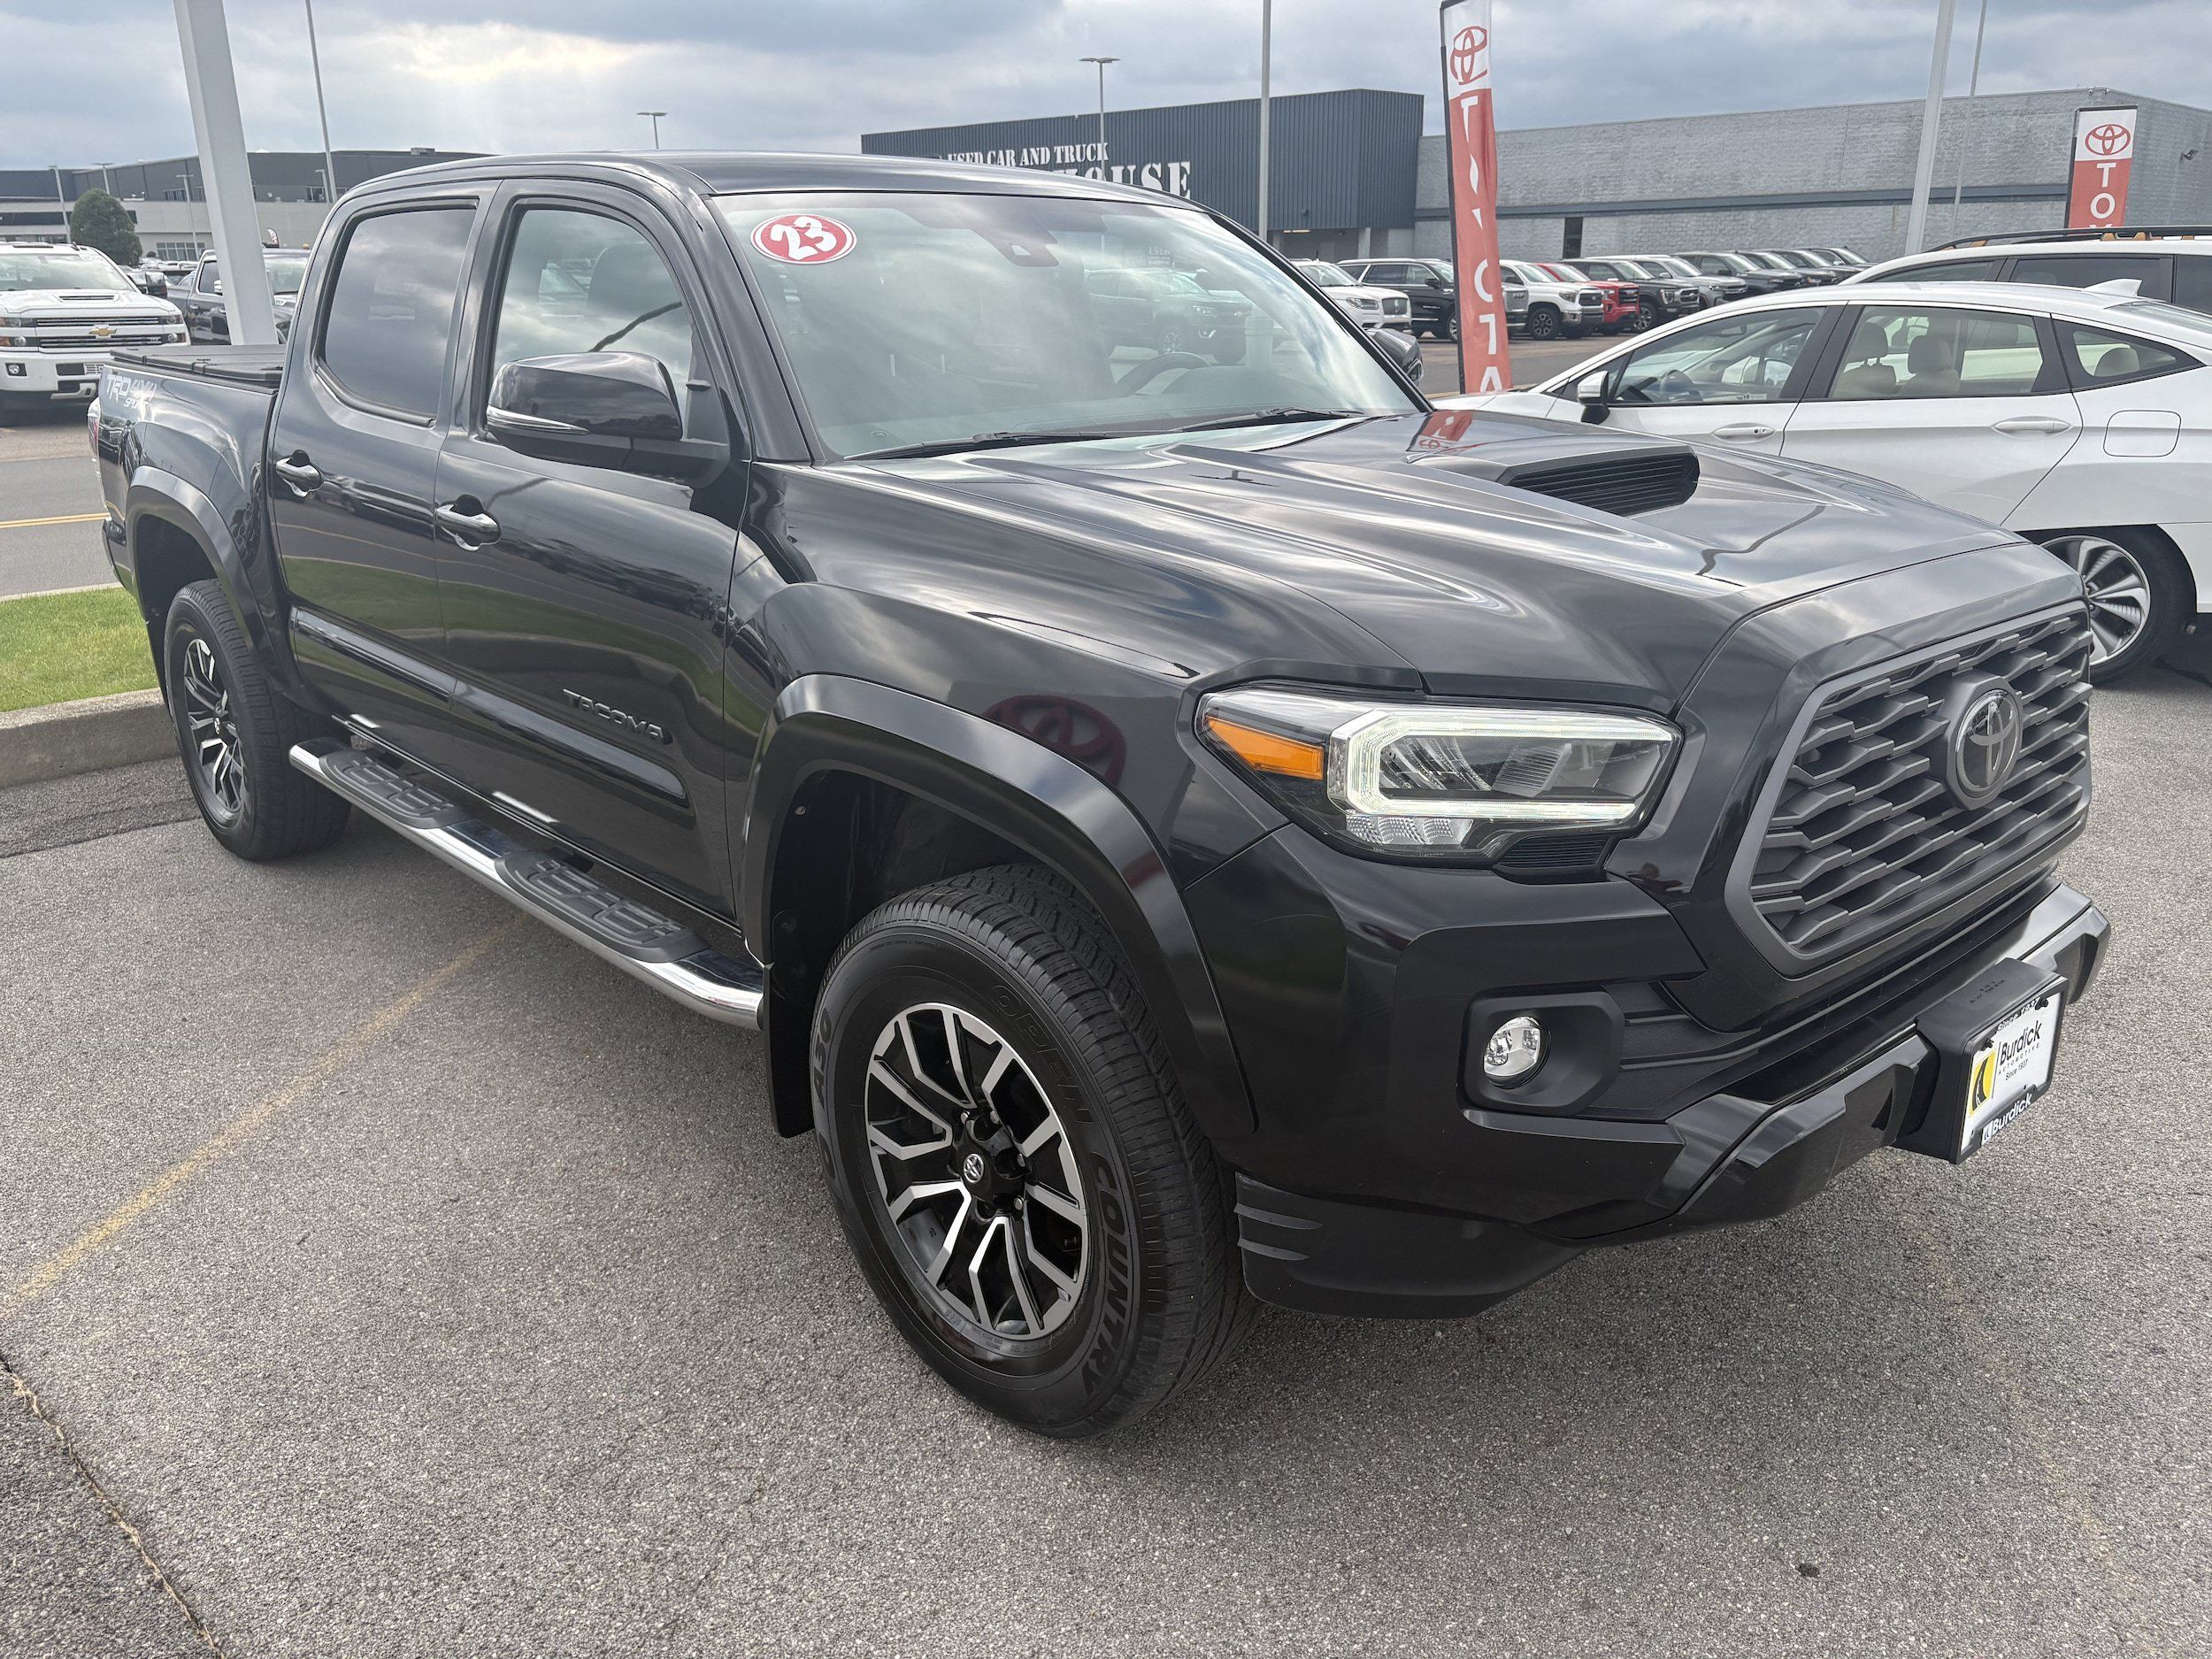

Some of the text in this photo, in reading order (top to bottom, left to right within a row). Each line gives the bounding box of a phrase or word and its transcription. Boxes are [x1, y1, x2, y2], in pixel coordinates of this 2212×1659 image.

[987, 149, 1017, 167] CAR
[1019, 146, 1051, 166] AND
[1053, 142, 1110, 165] TRUCK
[1053, 161, 1191, 200] USE
[2089, 162, 2117, 228] TO
[770, 216, 838, 261] 23
[1460, 95, 1502, 393] TOTA
[107, 373, 132, 403] TRD
[563, 688, 665, 741] TACOMA
[1998, 1042, 2039, 1075] AUTOMOTIVE
[2000, 1019, 2042, 1066] Burdick
[2005, 1068, 2017, 1080] Since
[1993, 1093, 2032, 1134] Burdick
[1081, 1151, 1129, 1396] COUNTRY
